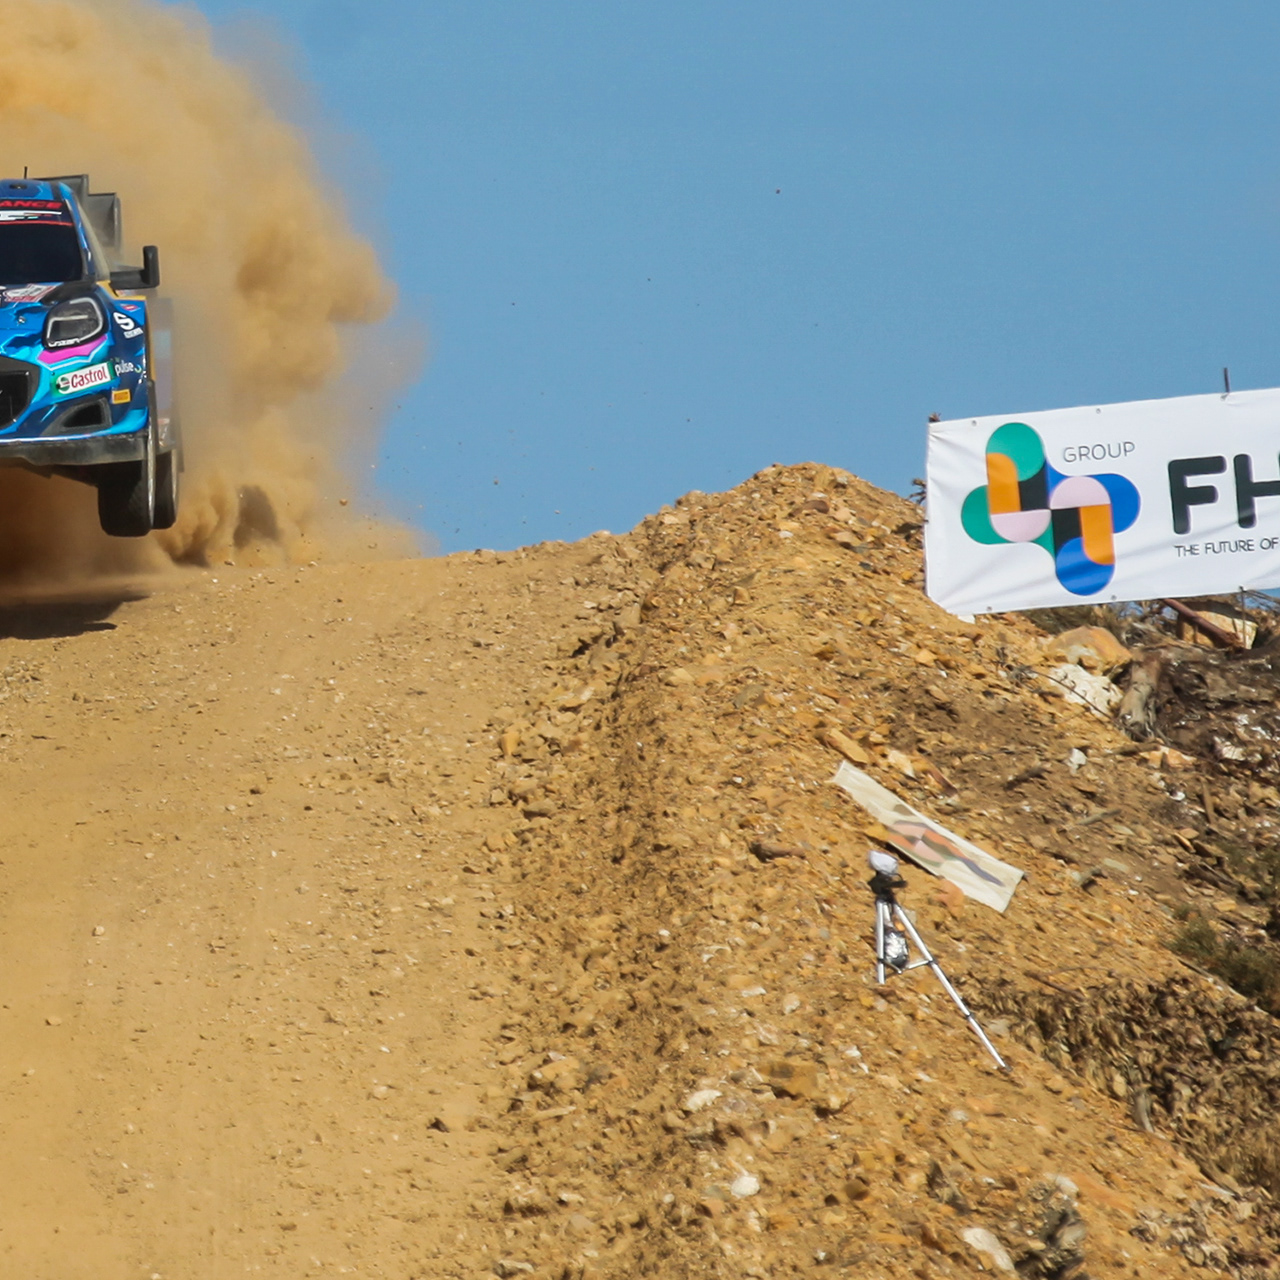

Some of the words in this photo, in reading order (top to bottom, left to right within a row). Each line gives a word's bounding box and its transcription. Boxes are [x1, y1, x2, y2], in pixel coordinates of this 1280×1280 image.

[71, 367, 108, 388] Castrol
[1063, 441, 1135, 463] GROUP
[1175, 544, 1200, 557] THE
[1205, 539, 1254, 554] FUTURE
[1260, 537, 1279, 550] OF
